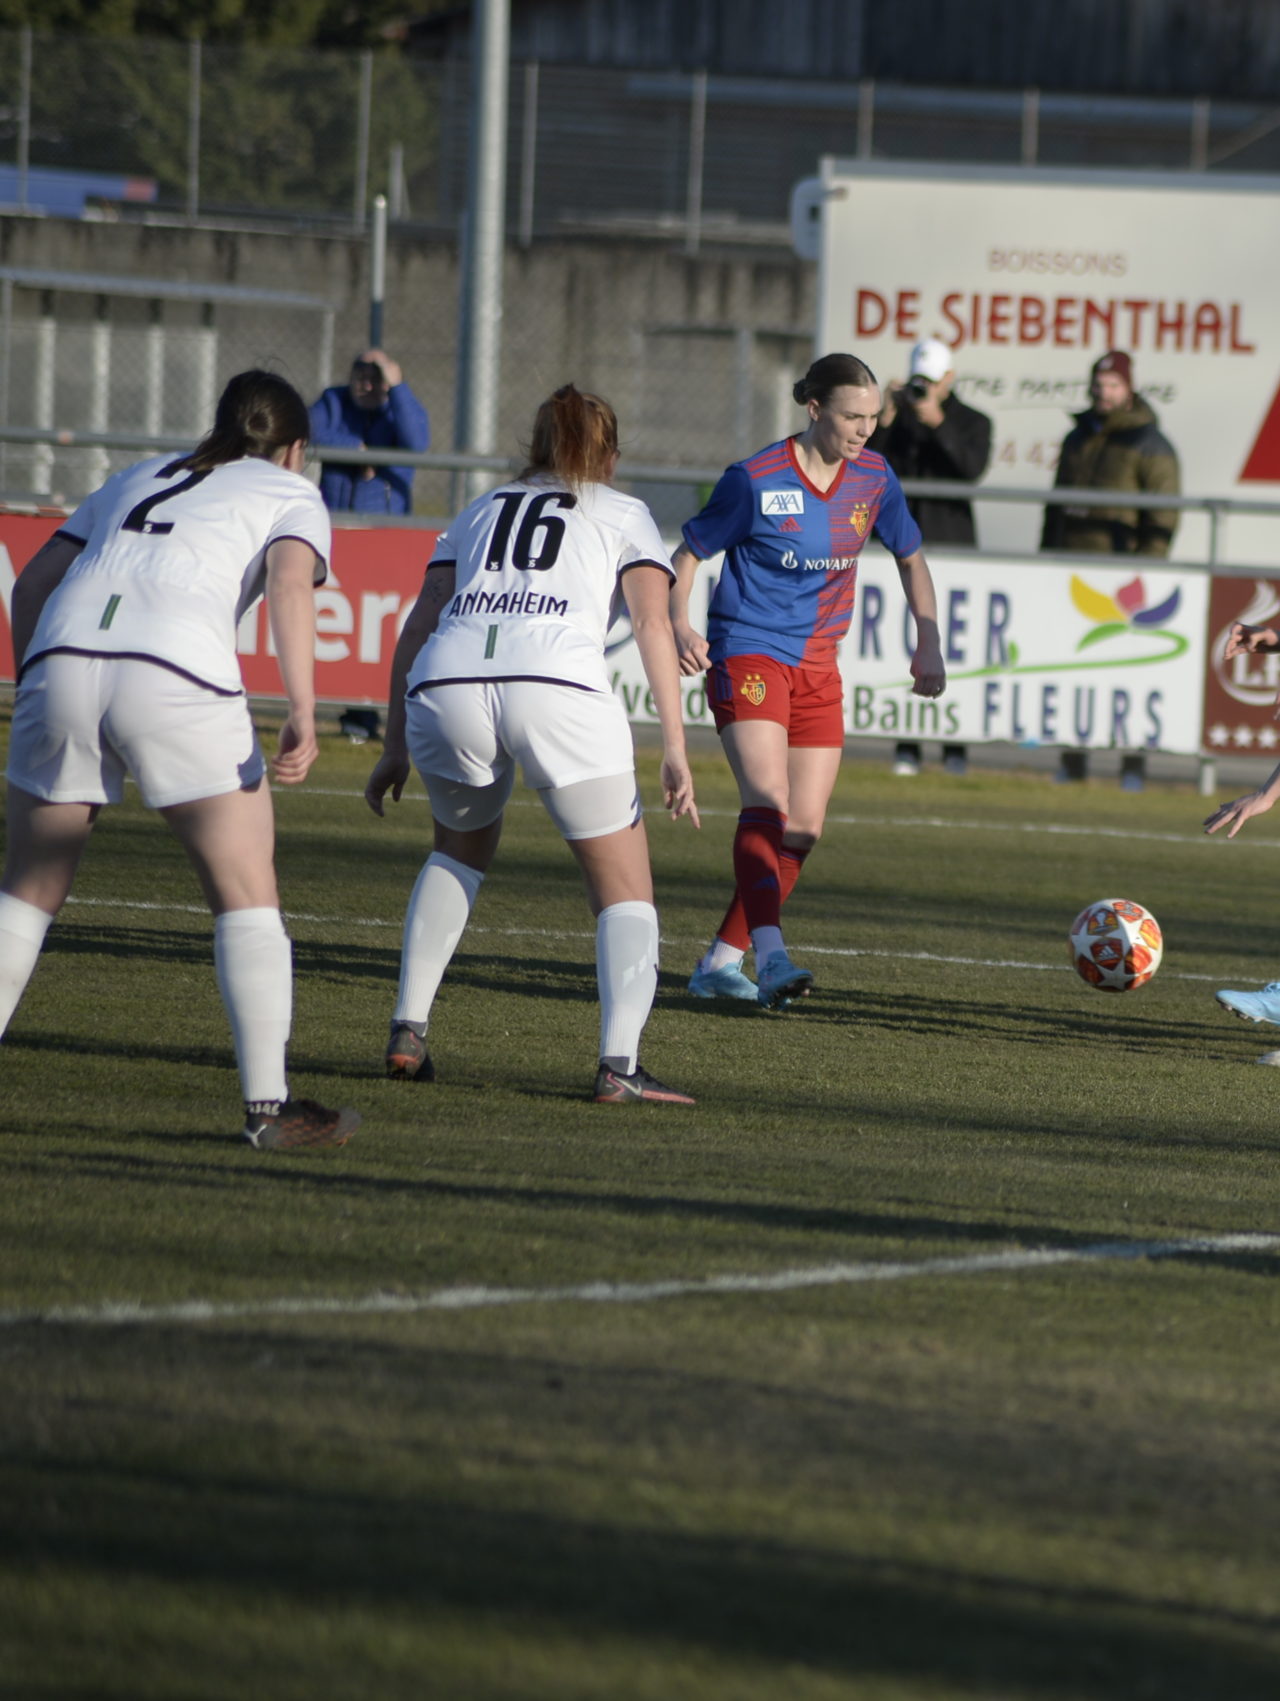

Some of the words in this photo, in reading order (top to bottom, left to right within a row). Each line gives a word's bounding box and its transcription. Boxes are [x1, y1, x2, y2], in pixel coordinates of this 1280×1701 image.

[989, 249, 1127, 277] BOISSONS
[855, 290, 920, 339] DE
[932, 292, 1256, 354] SIEBENTHAL
[121, 456, 215, 535] 2
[764, 493, 801, 512] AXA
[484, 491, 577, 572] 16
[447, 590, 569, 618] ANNAHEIM
[983, 682, 1163, 747] FLEURS
